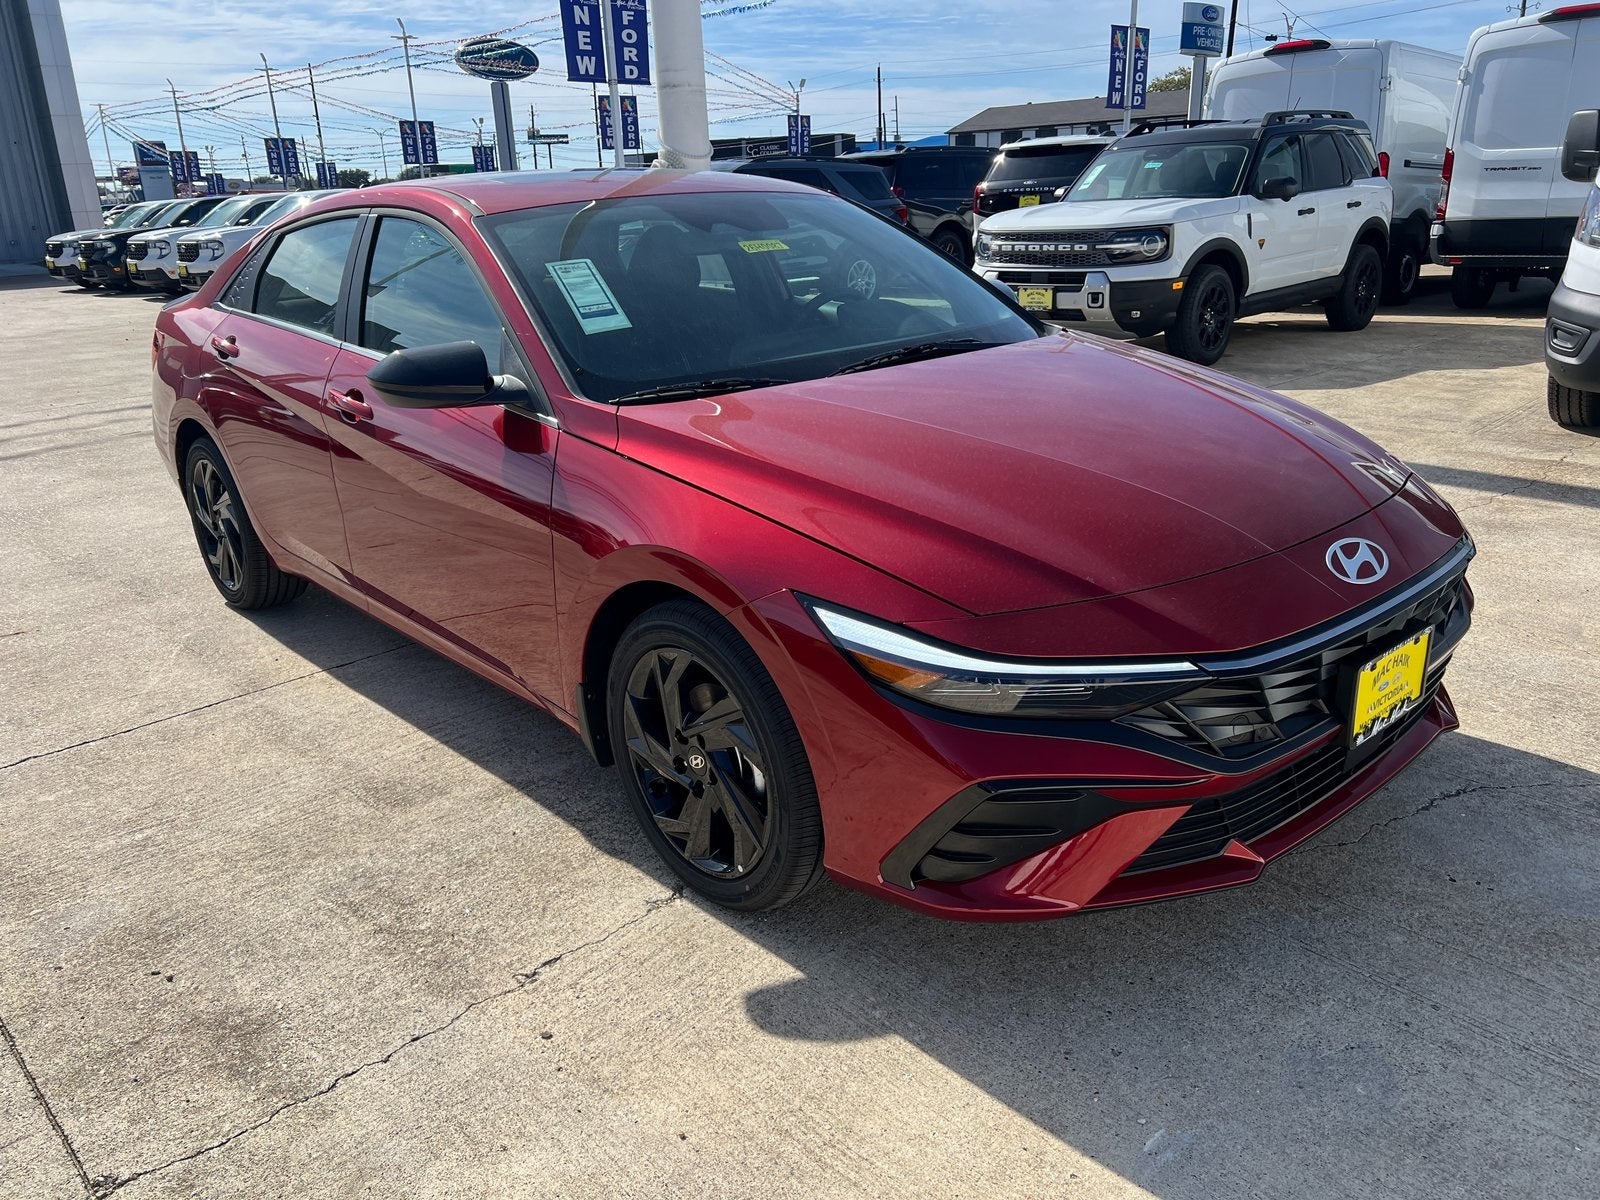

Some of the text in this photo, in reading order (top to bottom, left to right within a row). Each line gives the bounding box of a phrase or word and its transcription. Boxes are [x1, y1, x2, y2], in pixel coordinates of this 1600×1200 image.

[573, 5, 596, 75] NEW
[621, 10, 639, 79] FORD
[1112, 59, 1123, 104] NEW
[1133, 60, 1144, 105] FORD
[627, 116, 636, 147] FORD
[270, 152, 280, 173] NEW
[288, 152, 297, 173] FORD
[406, 138, 416, 163] NEW
[425, 138, 434, 163] FORD
[175, 163, 184, 181] NEW
[1001, 244, 1088, 252] BRONCO
